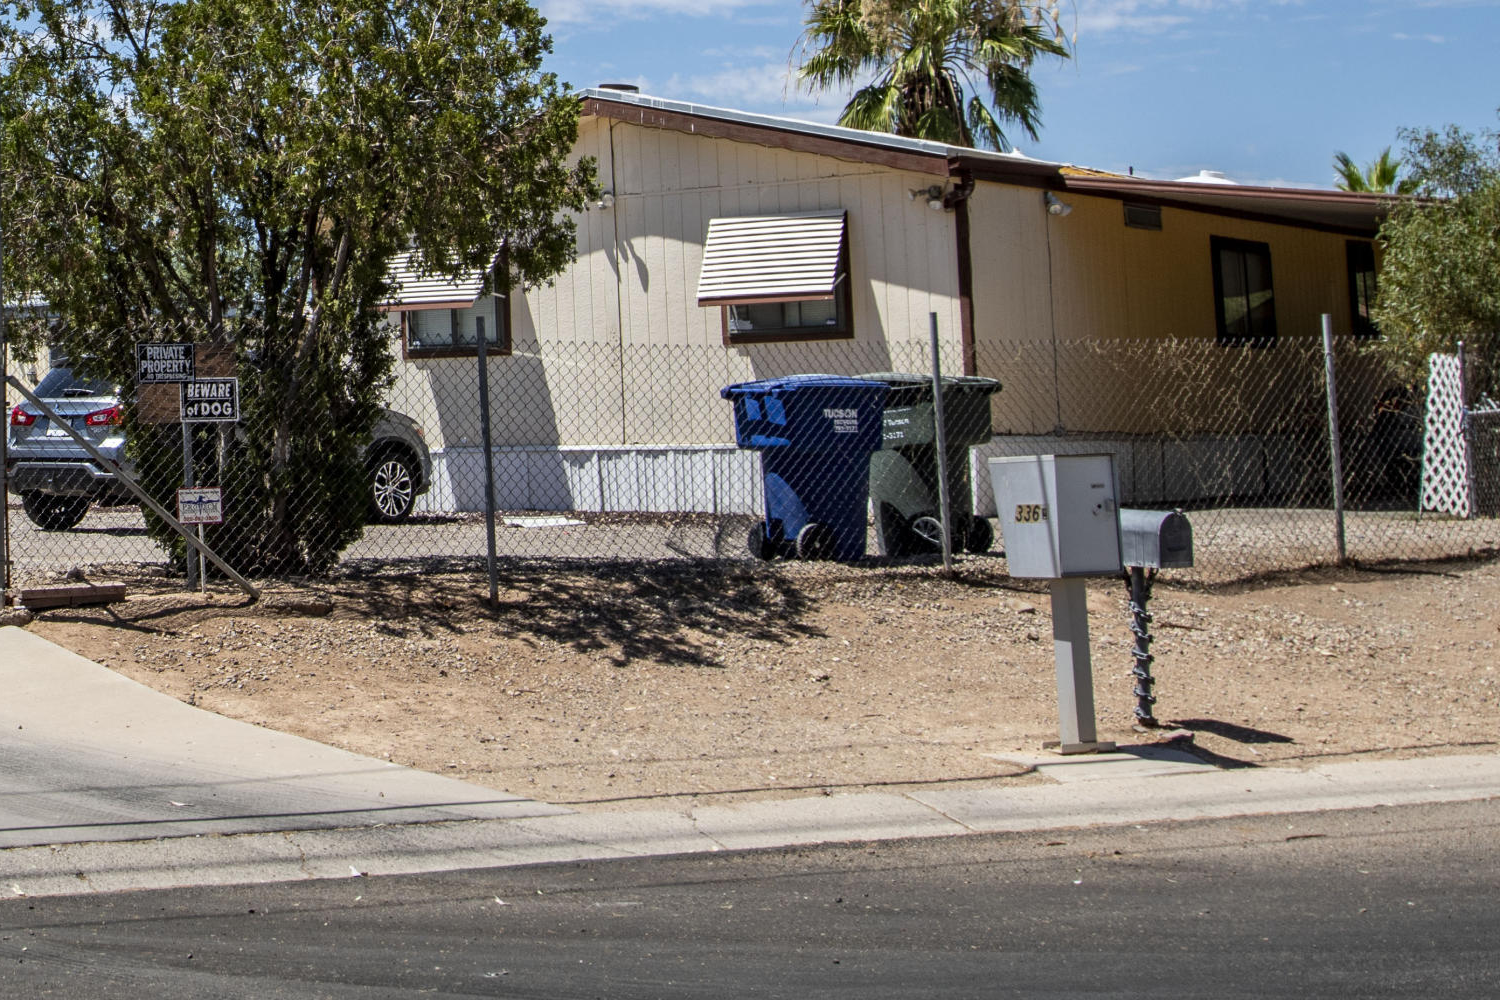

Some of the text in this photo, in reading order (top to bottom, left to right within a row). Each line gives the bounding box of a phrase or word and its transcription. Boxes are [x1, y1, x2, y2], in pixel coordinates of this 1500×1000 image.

[147, 346, 185, 360] PRIVATE
[141, 360, 191, 374] PROPERTY
[187, 383, 231, 398] BEWARE
[187, 401, 232, 416] of DOG
[823, 408, 858, 418] TUCSON
